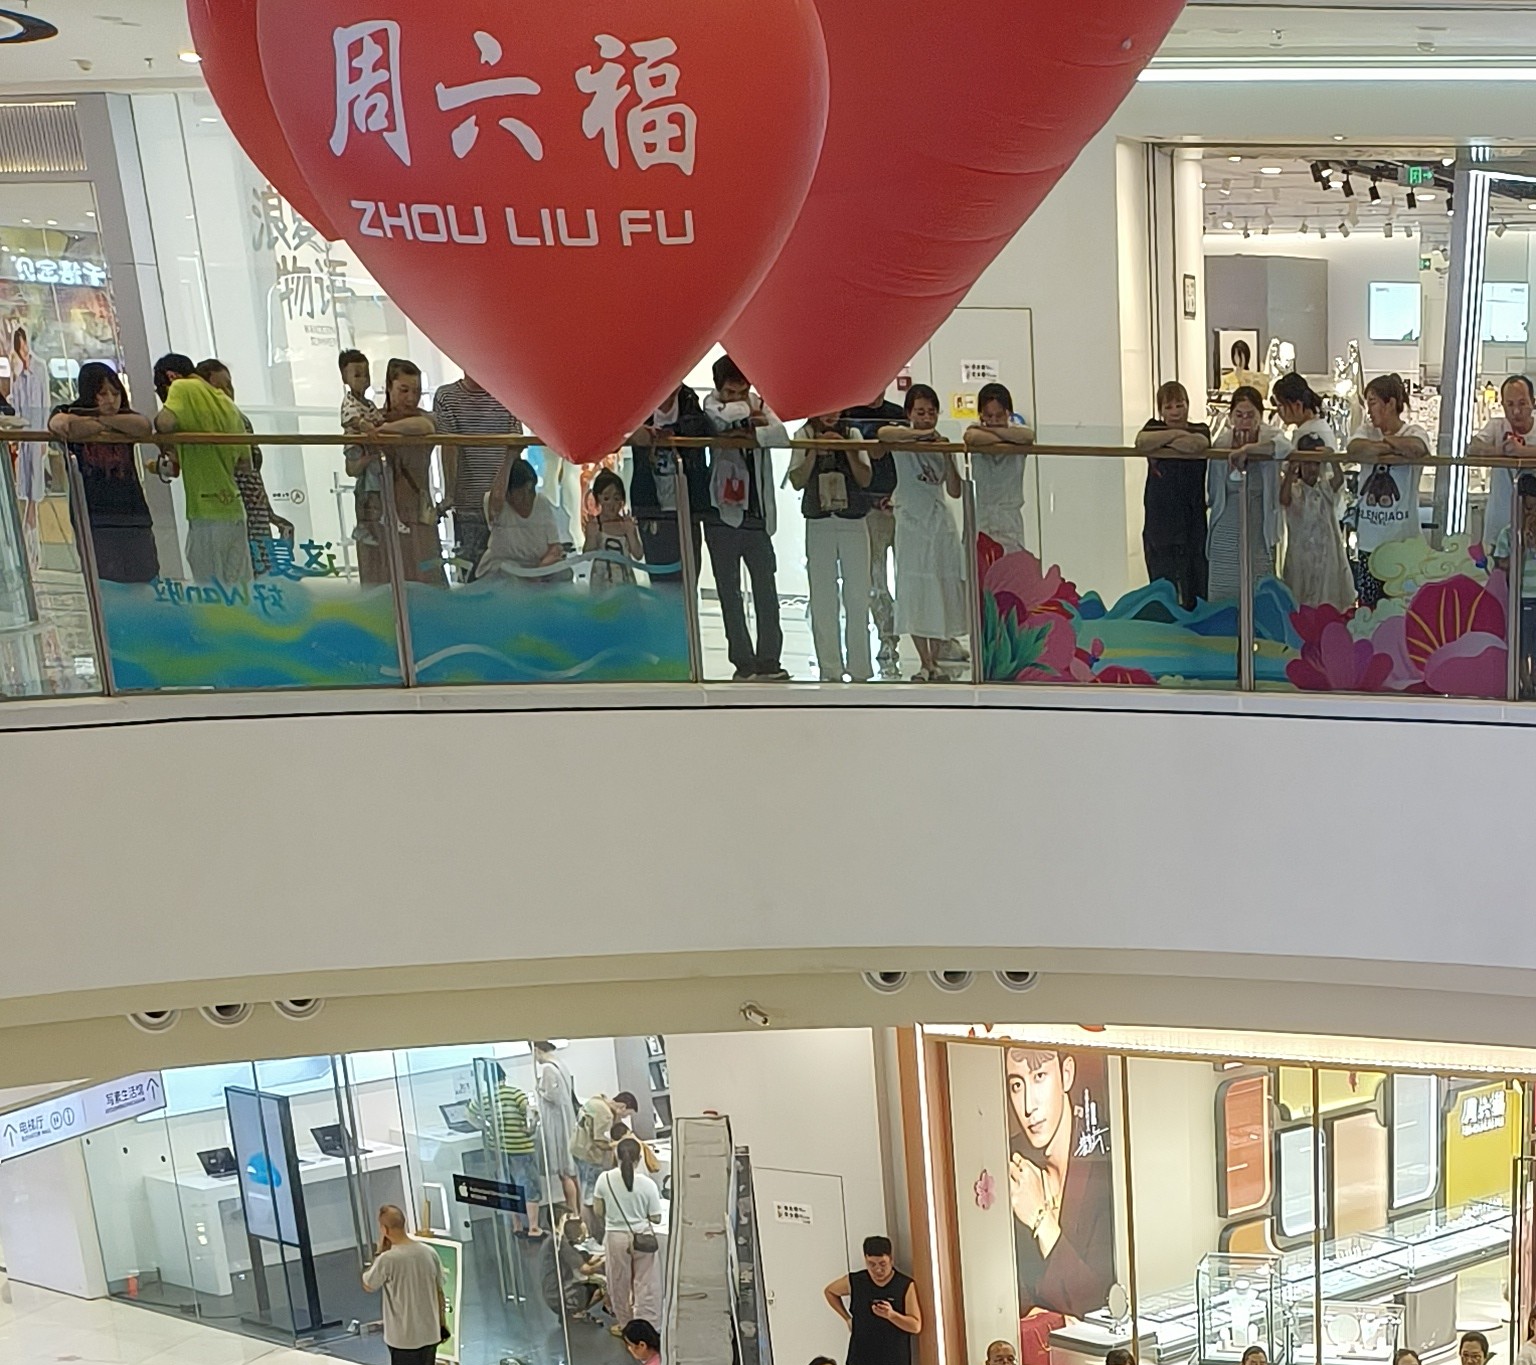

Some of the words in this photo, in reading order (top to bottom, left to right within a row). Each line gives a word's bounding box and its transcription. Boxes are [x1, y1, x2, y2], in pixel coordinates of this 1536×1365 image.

[329, 19, 697, 176] 周六福
[350, 200, 488, 245] ZHOU
[505, 206, 600, 247] LIU
[619, 209, 695, 247] FU
